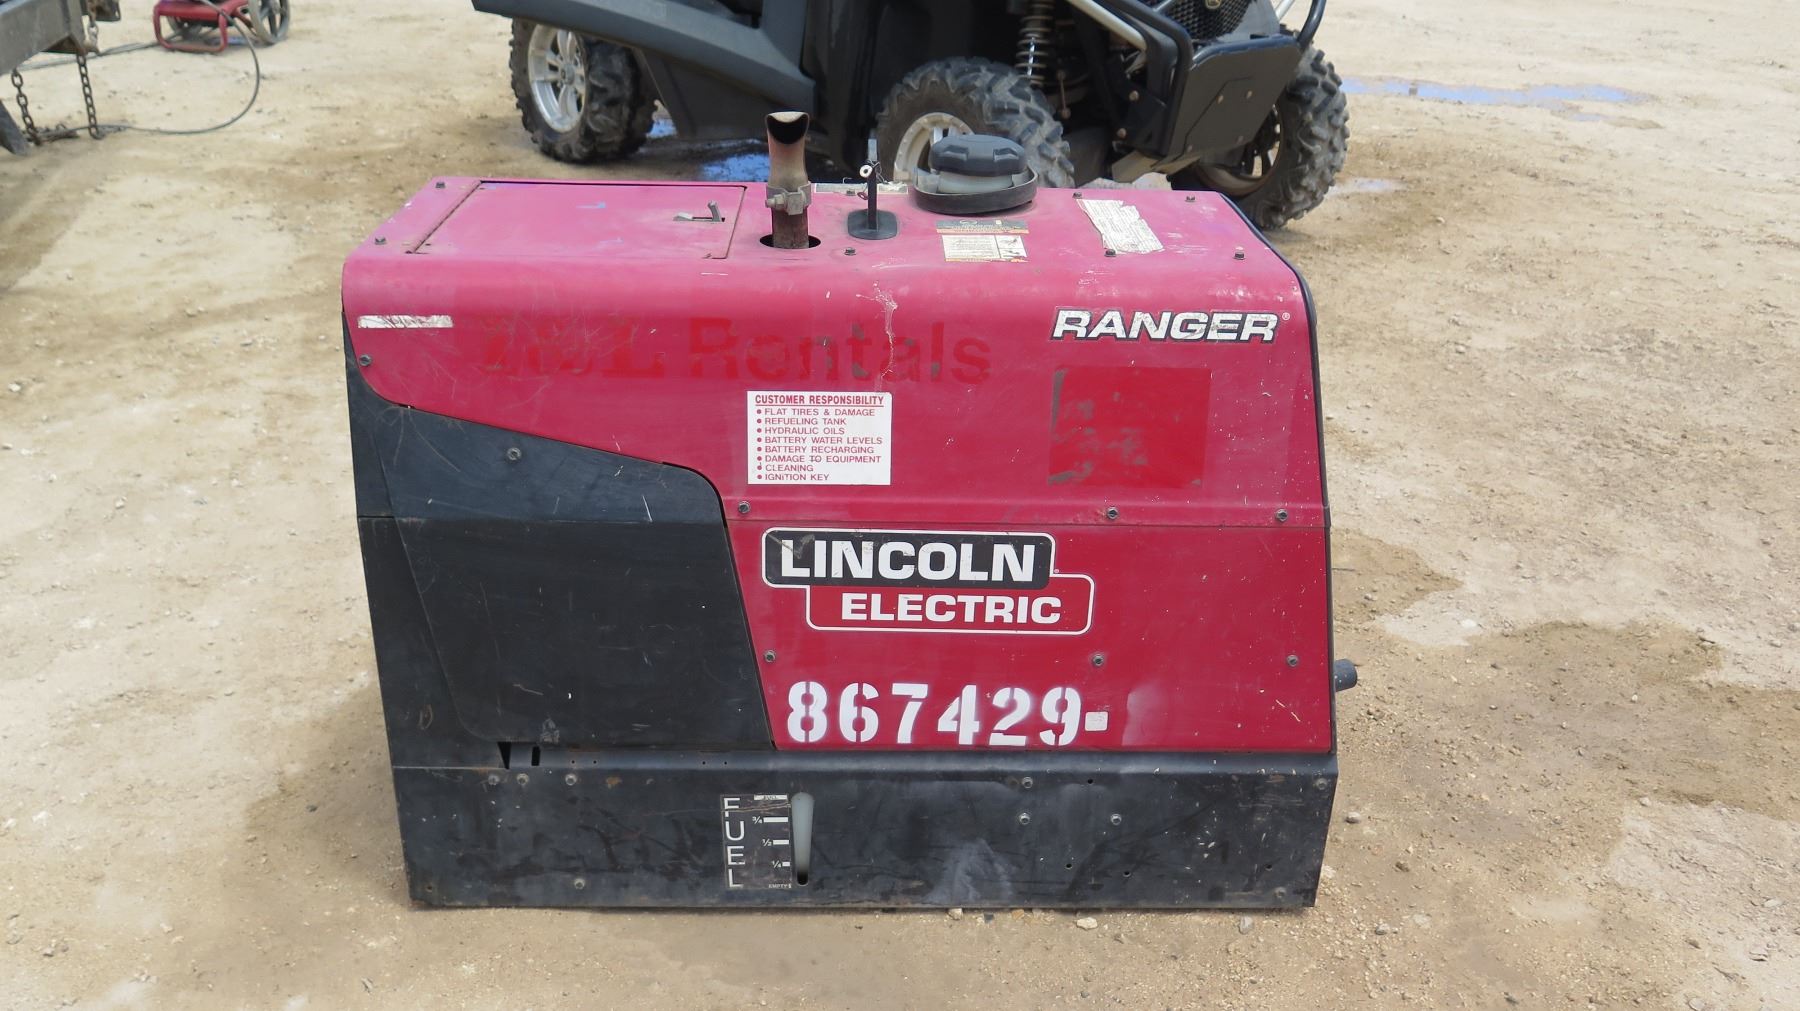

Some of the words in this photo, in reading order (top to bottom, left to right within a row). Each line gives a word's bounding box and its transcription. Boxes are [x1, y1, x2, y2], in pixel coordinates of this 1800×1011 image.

[1051, 309, 1279, 343] RANGER
[687, 315, 991, 382] Rentals
[755, 395, 805, 405] CUSTOMER
[809, 395, 884, 405] RESPONSIBILITY
[764, 408, 788, 416] FLAT
[792, 408, 819, 416] TIRES
[765, 427, 819, 435] HYDRAULIC
[809, 455, 822, 463] TO
[811, 446, 874, 454] RECHARGING
[765, 464, 814, 472] CLEANING
[782, 539, 1035, 582] LINCOLN
[842, 592, 1061, 624] ELECTRIC
[787, 681, 1082, 746] 867429
[724, 798, 745, 888] FUEL
